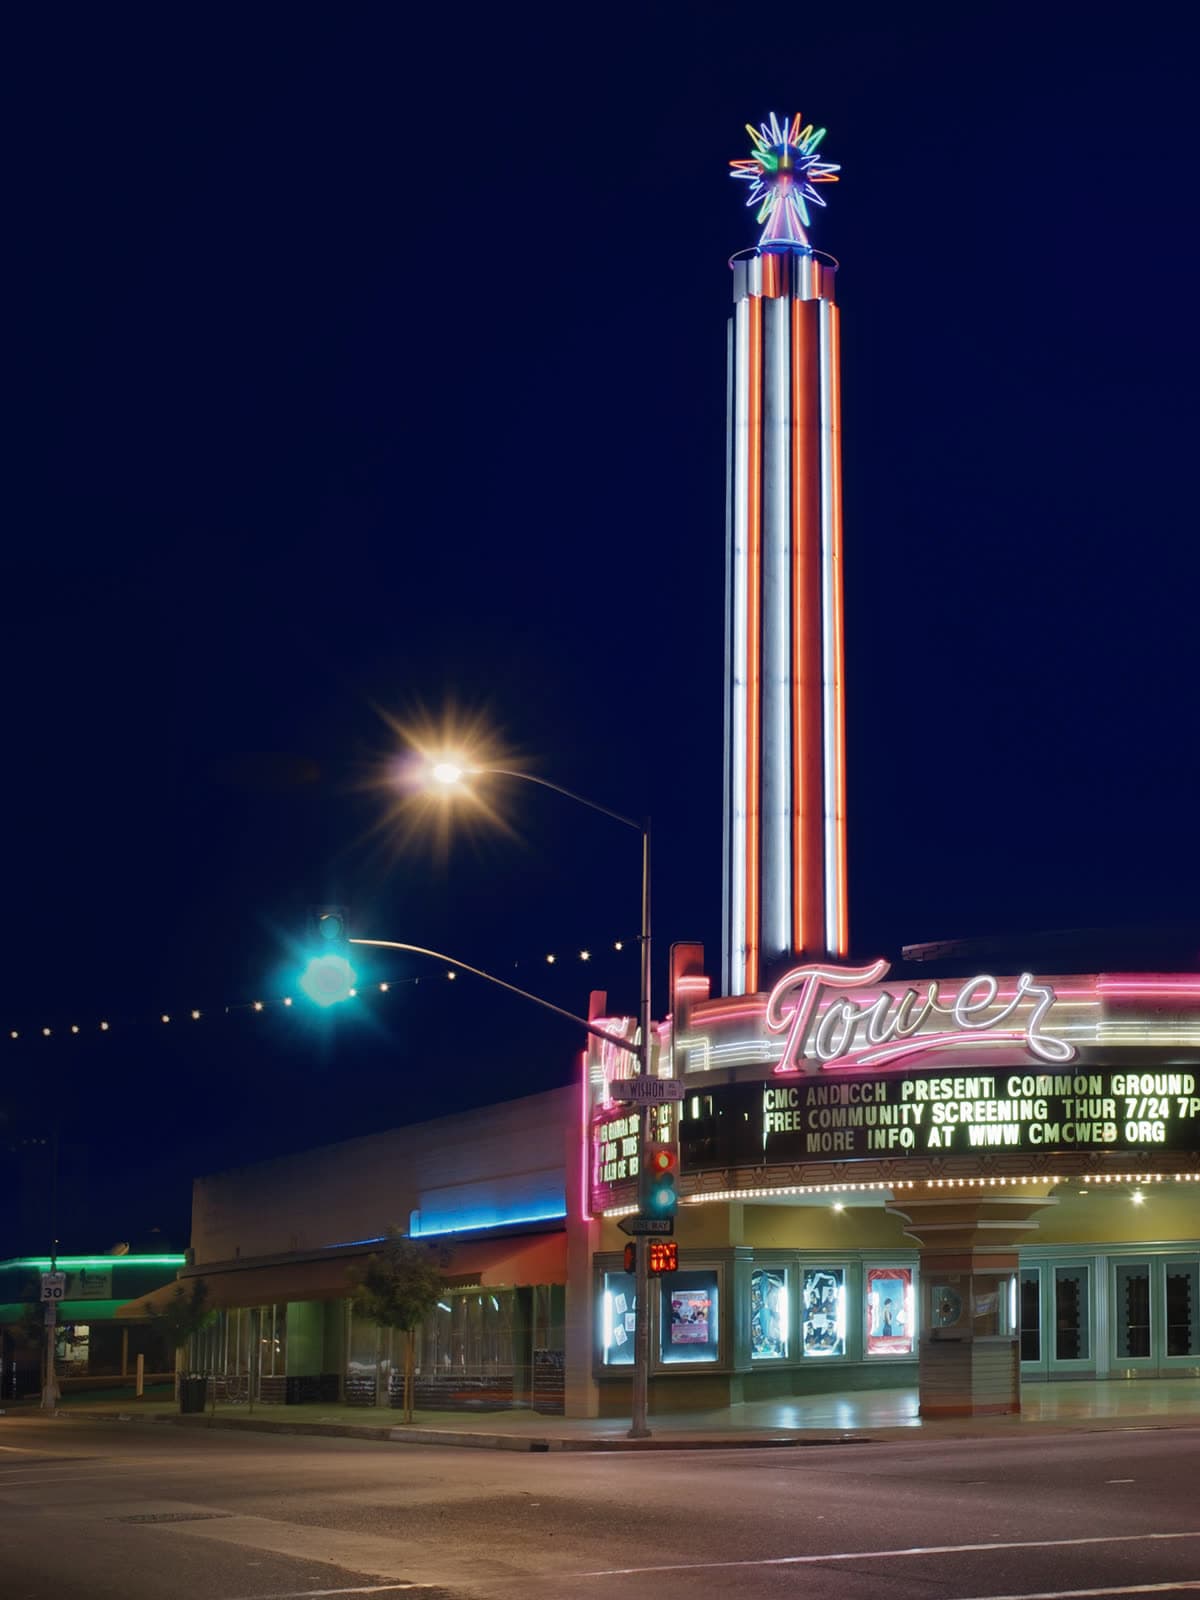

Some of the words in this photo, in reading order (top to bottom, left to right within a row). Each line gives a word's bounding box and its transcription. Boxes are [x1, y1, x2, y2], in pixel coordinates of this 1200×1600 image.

[766, 959, 1076, 1073] Tower
[630, 1082, 664, 1098] WISHON
[765, 1087, 799, 1110] CMC
[806, 1085, 842, 1107] AND
[902, 1077, 994, 1101] PRESENT
[1007, 1075, 1103, 1097] COMMON
[1111, 1074, 1196, 1096] GROUND
[766, 1110, 801, 1133] FREE
[808, 1103, 925, 1129] COMMUNITY
[931, 1099, 1049, 1124] SCREENING
[1062, 1099, 1116, 1120] THUR
[1125, 1097, 1170, 1119] 7/24
[806, 1131, 855, 1152] MORE
[868, 1127, 914, 1150] INFO
[927, 1126, 956, 1148] AT
[969, 1123, 1020, 1146] WWW
[1028, 1121, 1117, 1144] CMCWEB
[1125, 1121, 1166, 1143] ORG
[44, 1287, 62, 1298] 30
